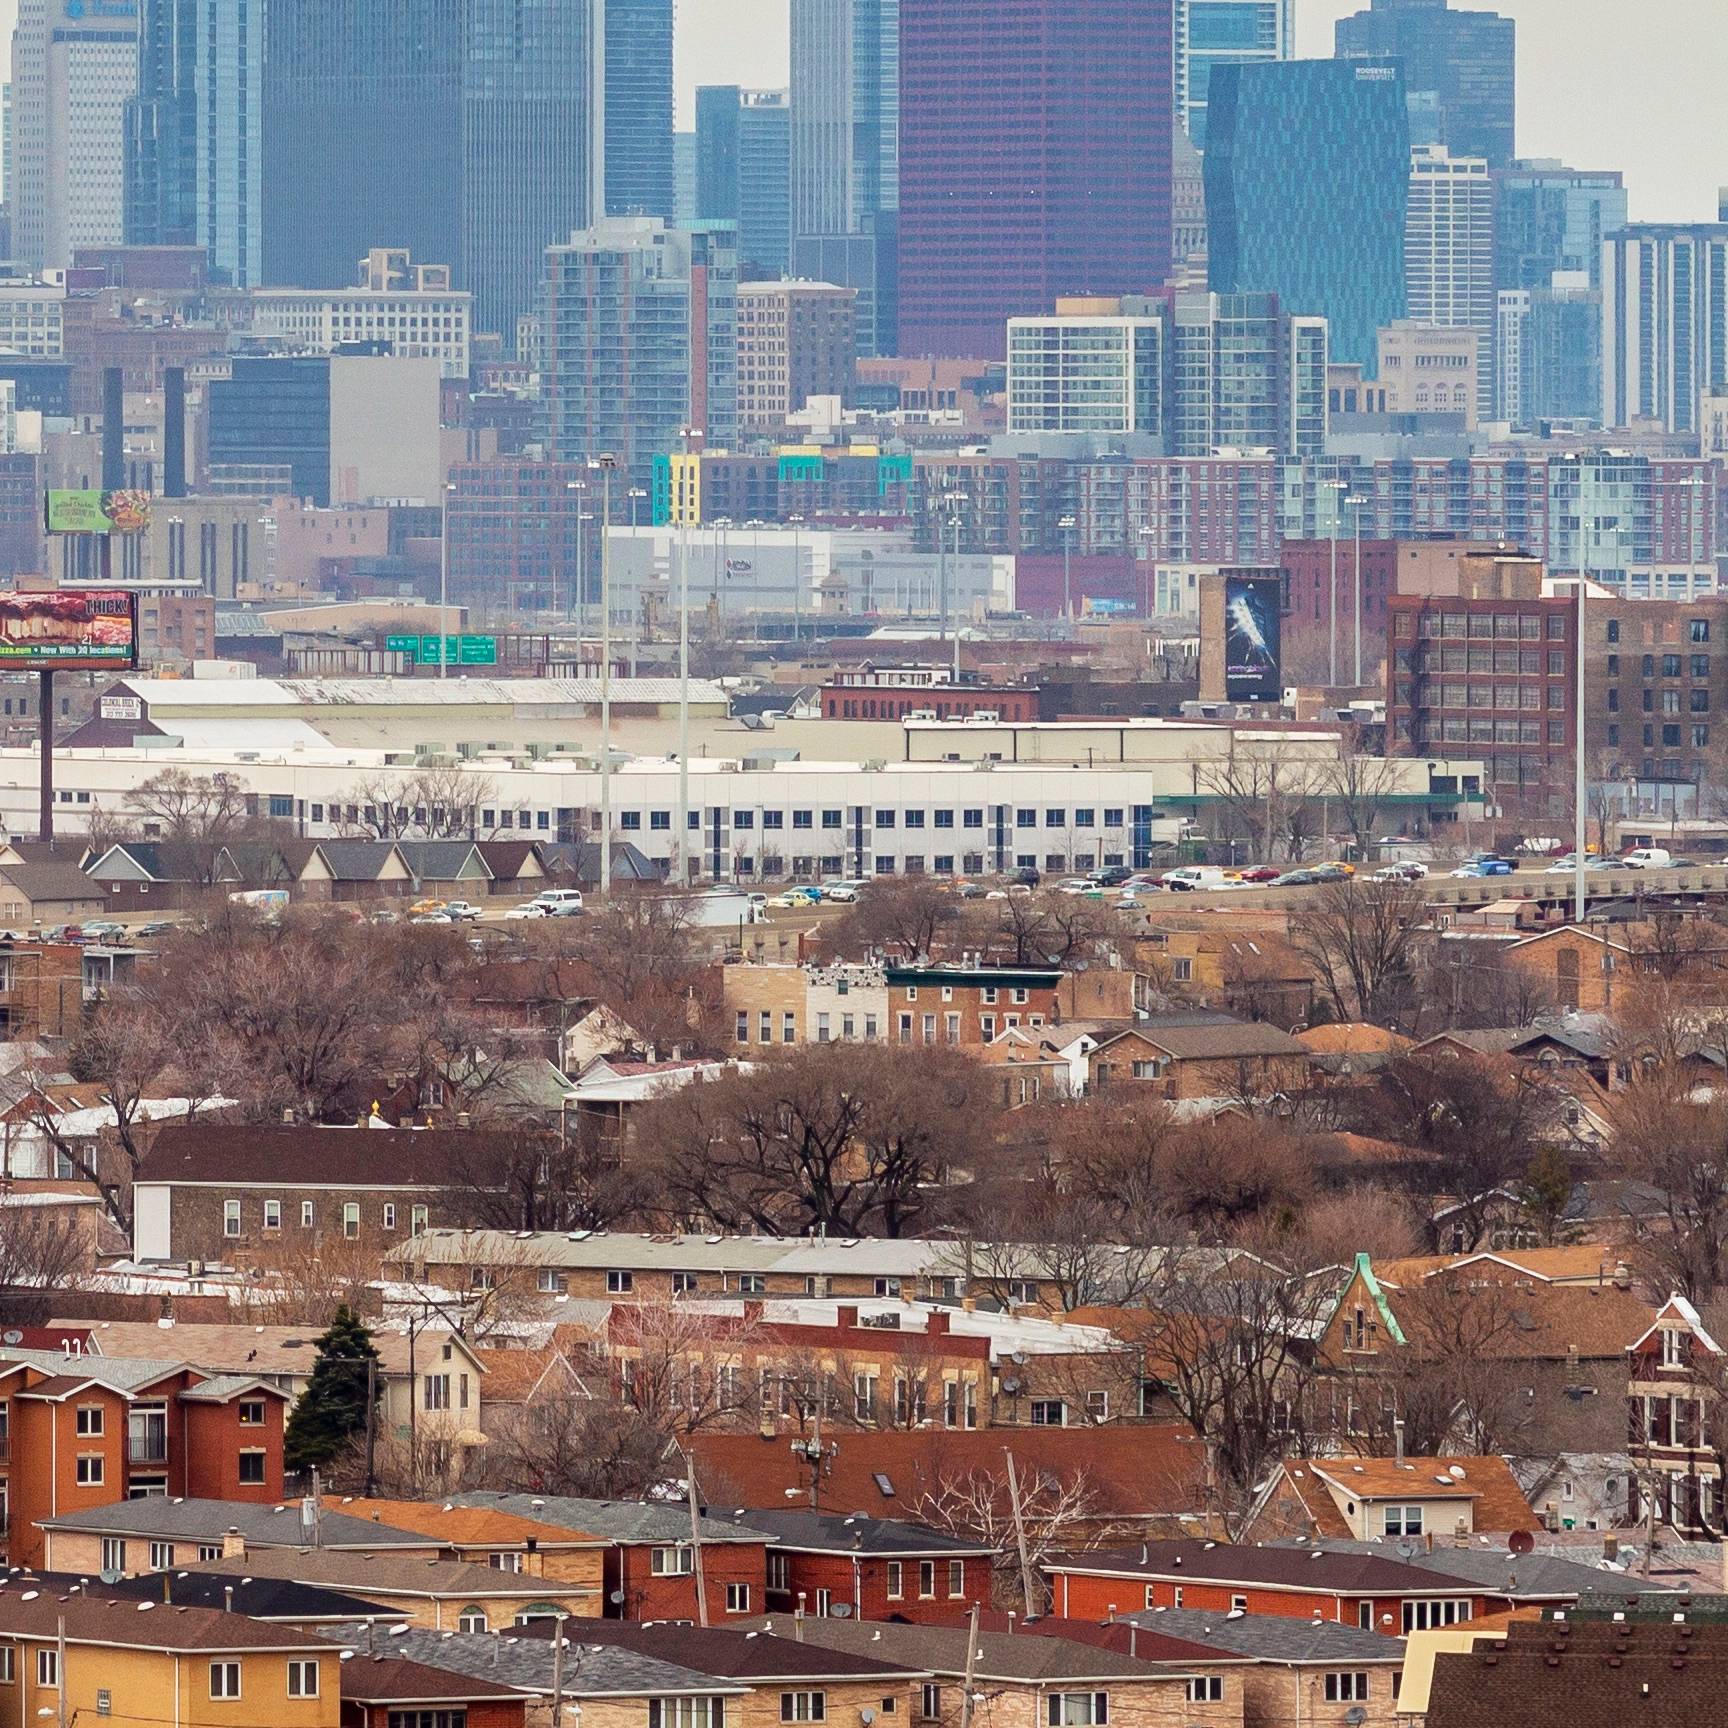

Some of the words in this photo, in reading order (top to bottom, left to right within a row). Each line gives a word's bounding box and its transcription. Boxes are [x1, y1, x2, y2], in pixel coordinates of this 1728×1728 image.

[85, 599, 129, 615] THICK!
[40, 646, 58, 654] Now
[59, 646, 77, 654] With
[89, 646, 127, 655] locations!
